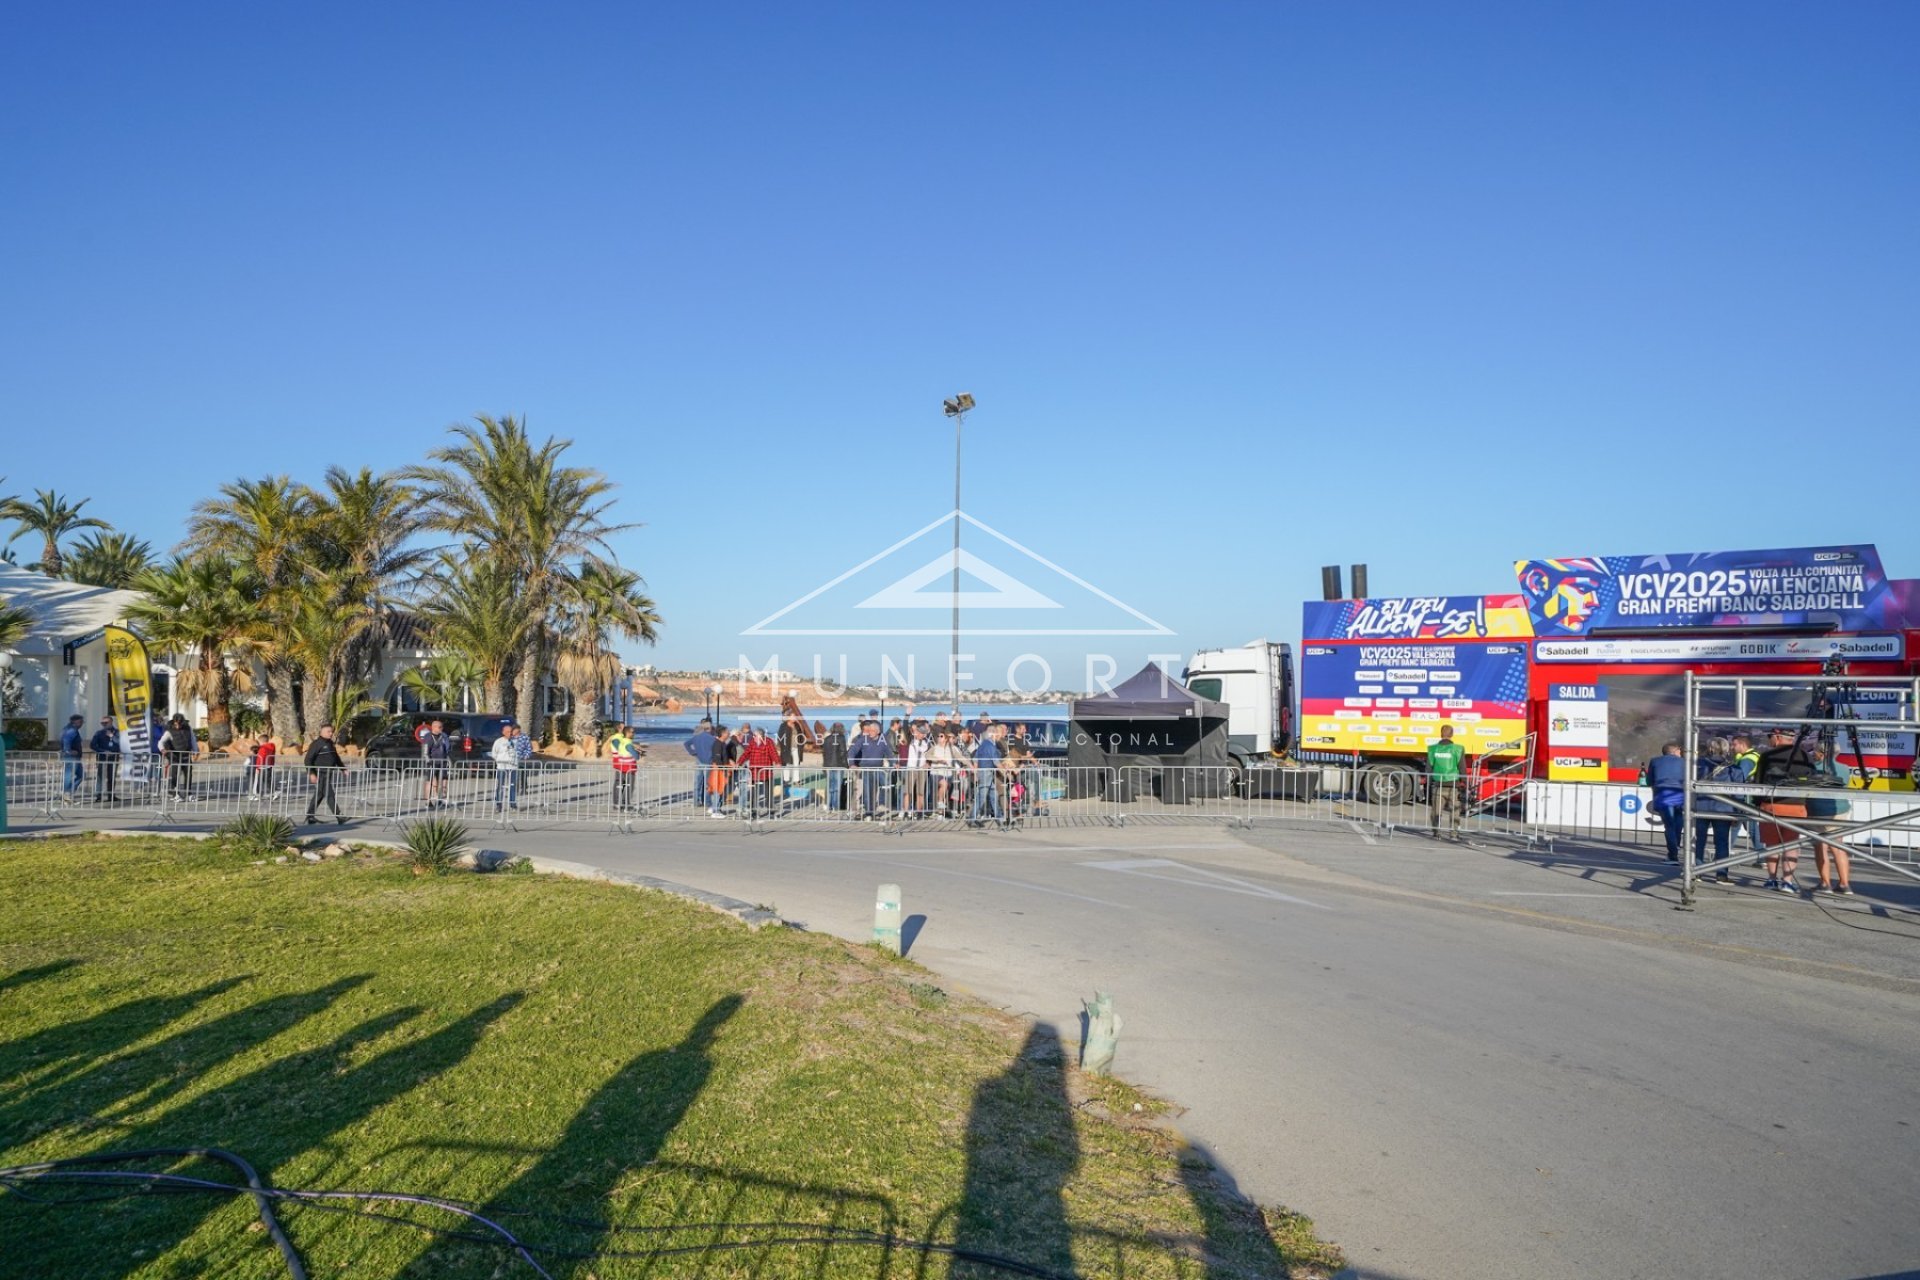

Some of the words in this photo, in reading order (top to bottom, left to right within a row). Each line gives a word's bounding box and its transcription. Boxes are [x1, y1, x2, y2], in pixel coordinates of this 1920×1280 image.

[1749, 568, 1779, 579] VOLTA
[1781, 568, 1789, 578] A
[1790, 567, 1804, 577] LA
[1805, 564, 1865, 577] COMUNITAT
[1618, 570, 1747, 600] VCV2025
[1749, 576, 1865, 596] VALENCIANA
[1618, 599, 1662, 616] GRAN
[1664, 597, 1717, 615] PREMI
[1720, 595, 1767, 613] BANC
[1769, 592, 1865, 611] SABADELL
[1359, 646, 1412, 659] VCV2025
[1545, 645, 1589, 656] Sabadell
[1740, 643, 1777, 654] GOBIK
[1838, 642, 1893, 653] Sabadell
[1393, 671, 1426, 680] Sabadell
[1558, 685, 1596, 699] SALIDA
[1855, 731, 1898, 740] ENTENARIO
[1887, 741, 1905, 750] RUIZ
[1555, 758, 1572, 766] UCI
